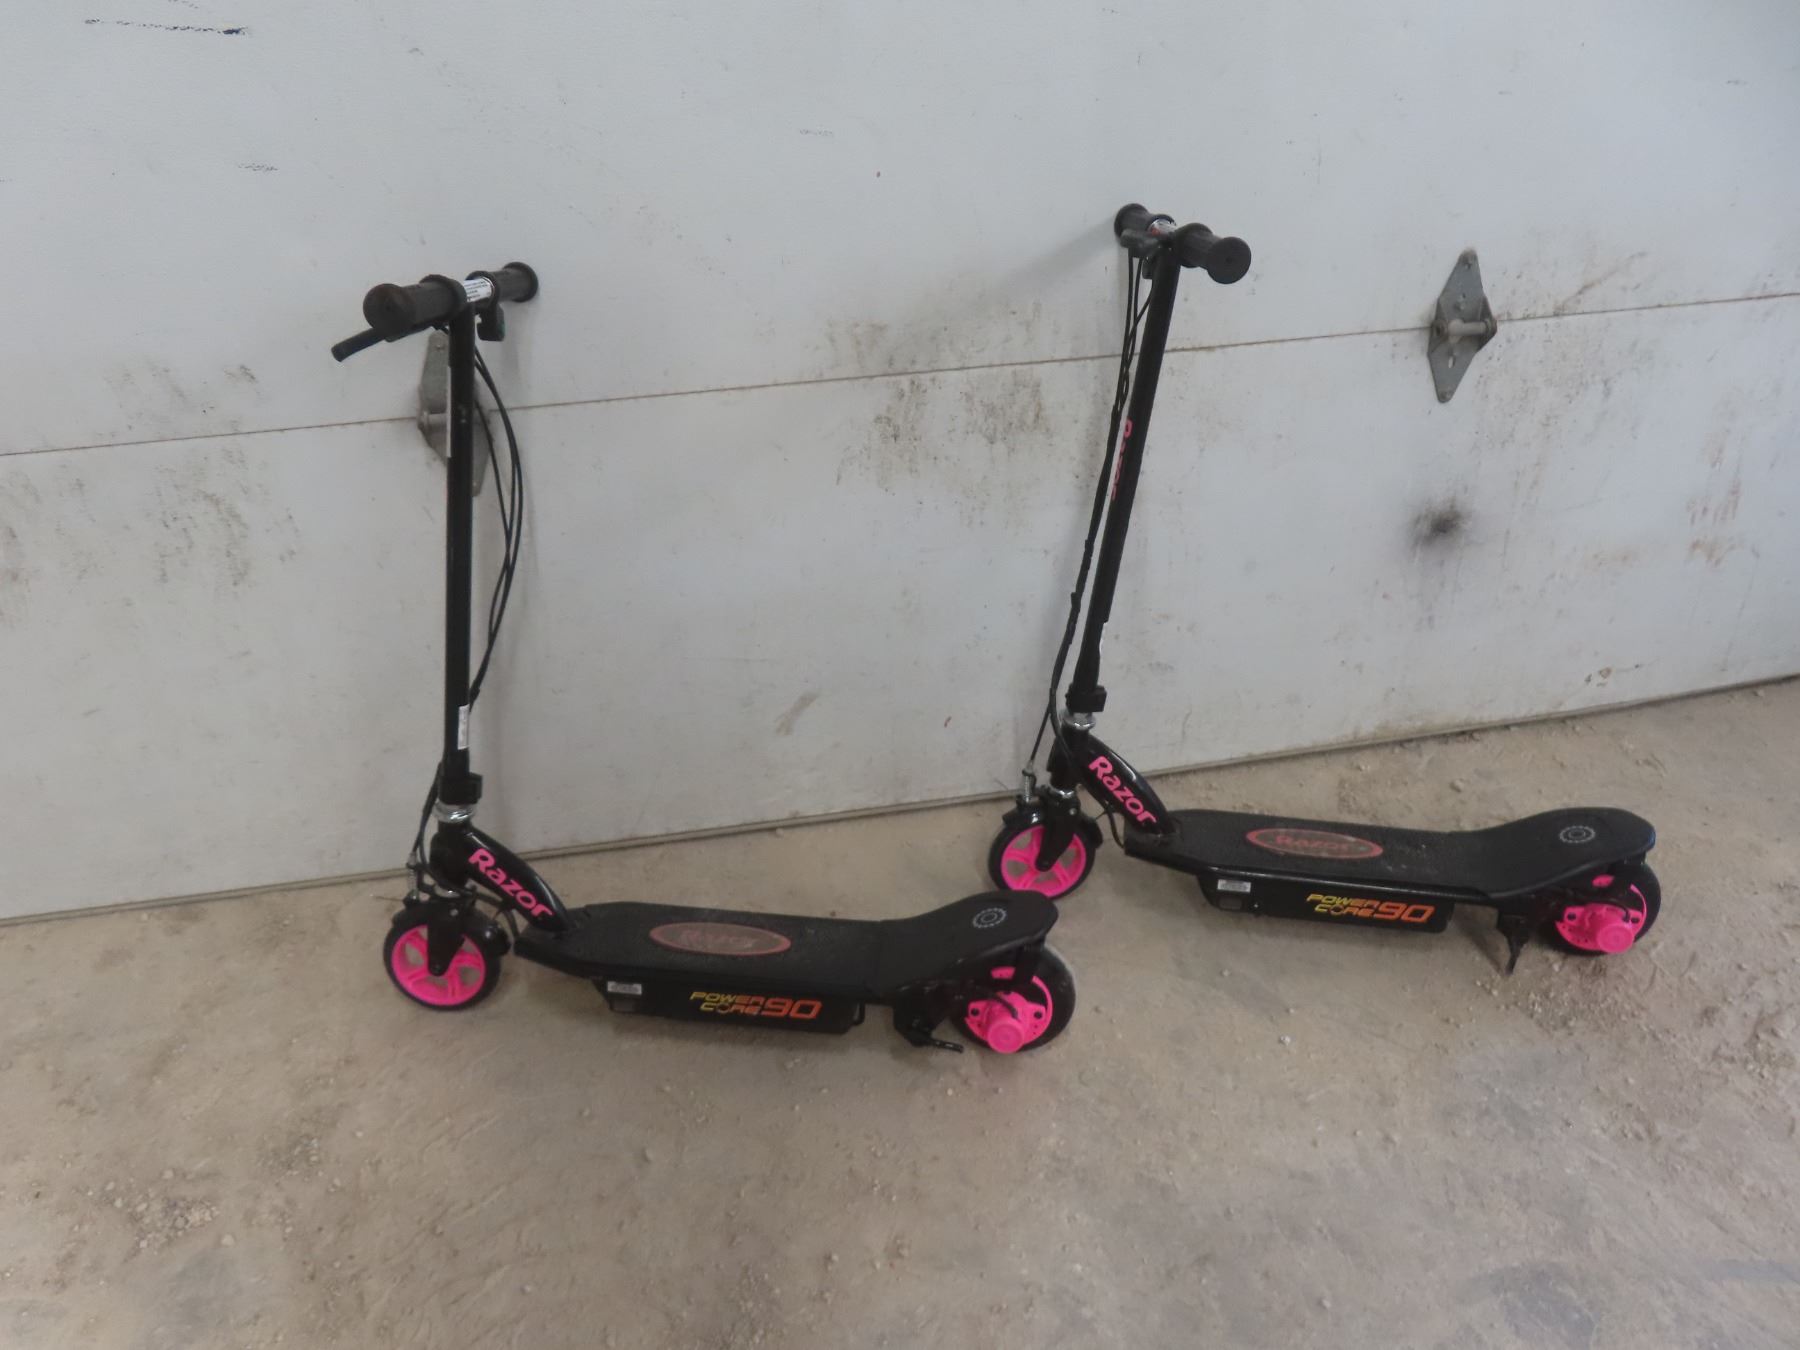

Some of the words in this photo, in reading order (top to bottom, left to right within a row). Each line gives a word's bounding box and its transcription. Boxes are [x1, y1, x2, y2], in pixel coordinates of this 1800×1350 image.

[1088, 756, 1157, 823] Razor
[468, 848, 553, 917] Razor
[1306, 893, 1381, 907] POWER
[1314, 904, 1376, 918] CORE
[1373, 901, 1436, 923] 90
[689, 991, 766, 1005] POWER
[699, 1002, 763, 1015] CORE
[761, 998, 823, 1019] 90
